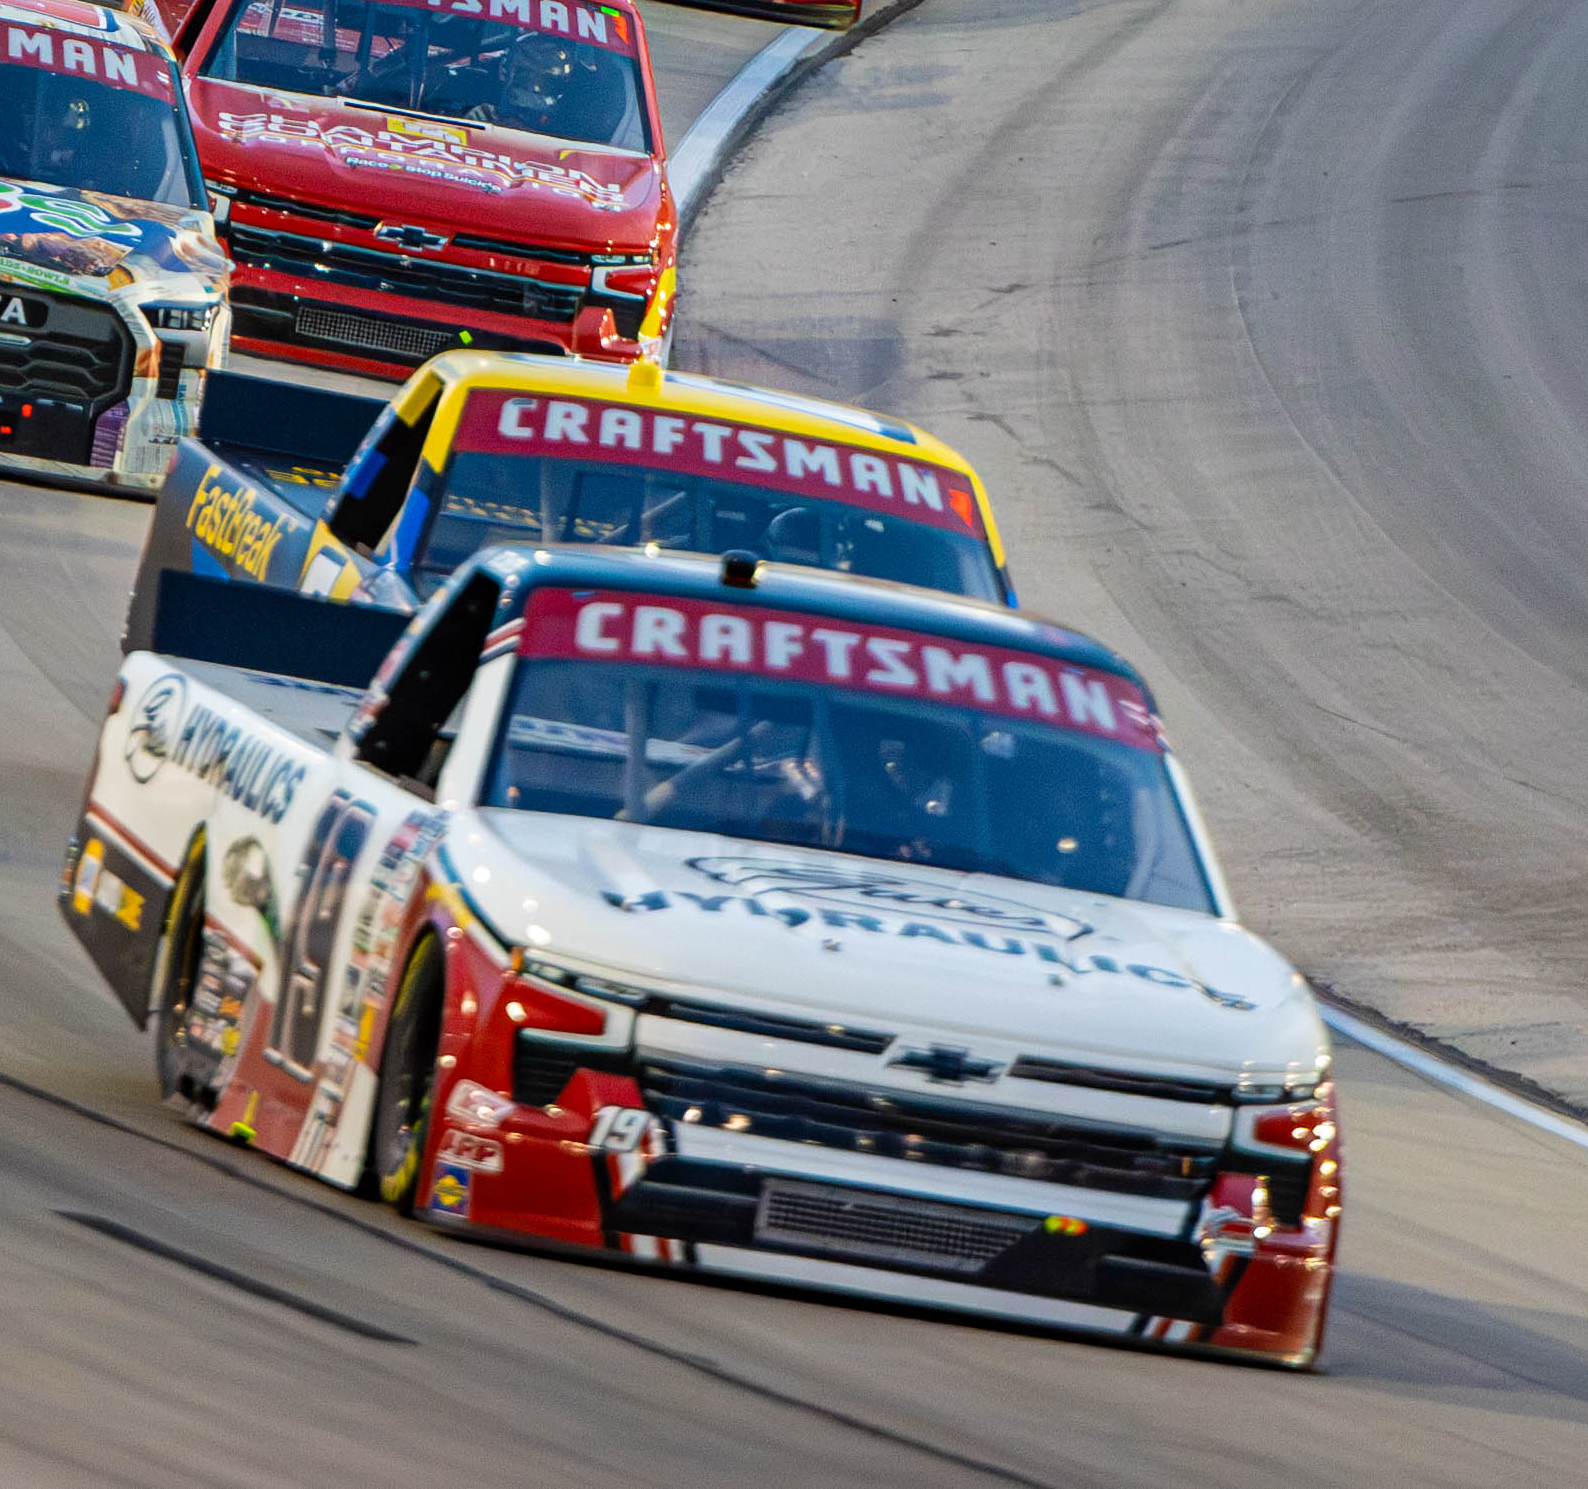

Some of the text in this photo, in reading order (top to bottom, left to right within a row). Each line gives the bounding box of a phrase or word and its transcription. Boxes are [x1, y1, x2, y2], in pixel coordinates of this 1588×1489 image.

[497, 396, 944, 512] CRAFTSMAN
[574, 599, 1118, 732] CRAFTSMAN
[172, 703, 307, 825] HYDRAULICS
[588, 1104, 653, 1153] 19
